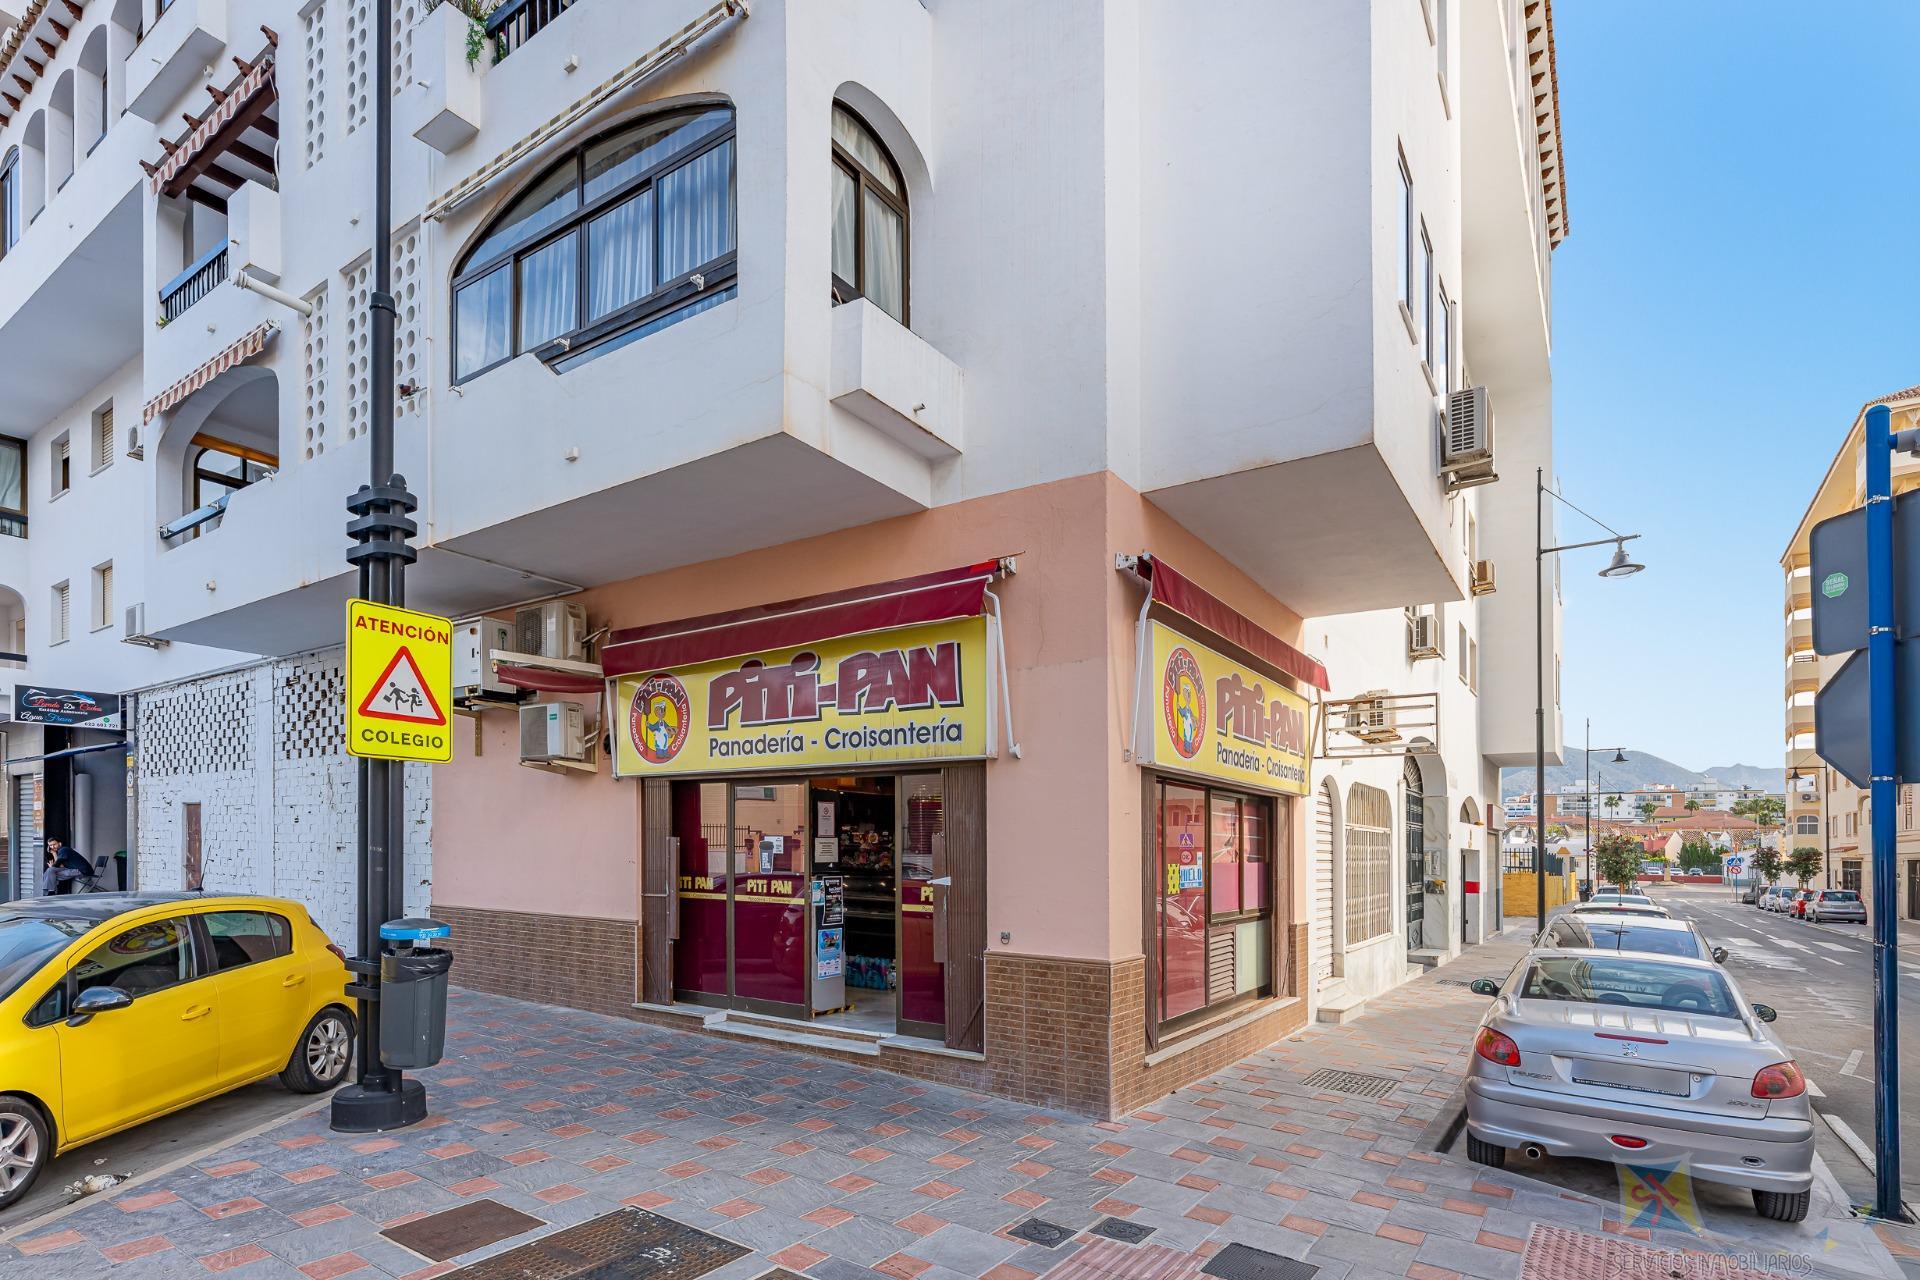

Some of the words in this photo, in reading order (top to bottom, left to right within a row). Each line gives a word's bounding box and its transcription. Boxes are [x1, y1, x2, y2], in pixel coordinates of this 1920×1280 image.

[355, 615, 449, 645] ATENCIÓN
[361, 728, 443, 748] COLEGIO
[709, 729, 804, 758] Panadería
[824, 718, 963, 751] Croisantería
[1216, 741, 1260, 772] Panadería
[695, 876, 714, 890] PAN
[771, 879, 792, 894] PAN
